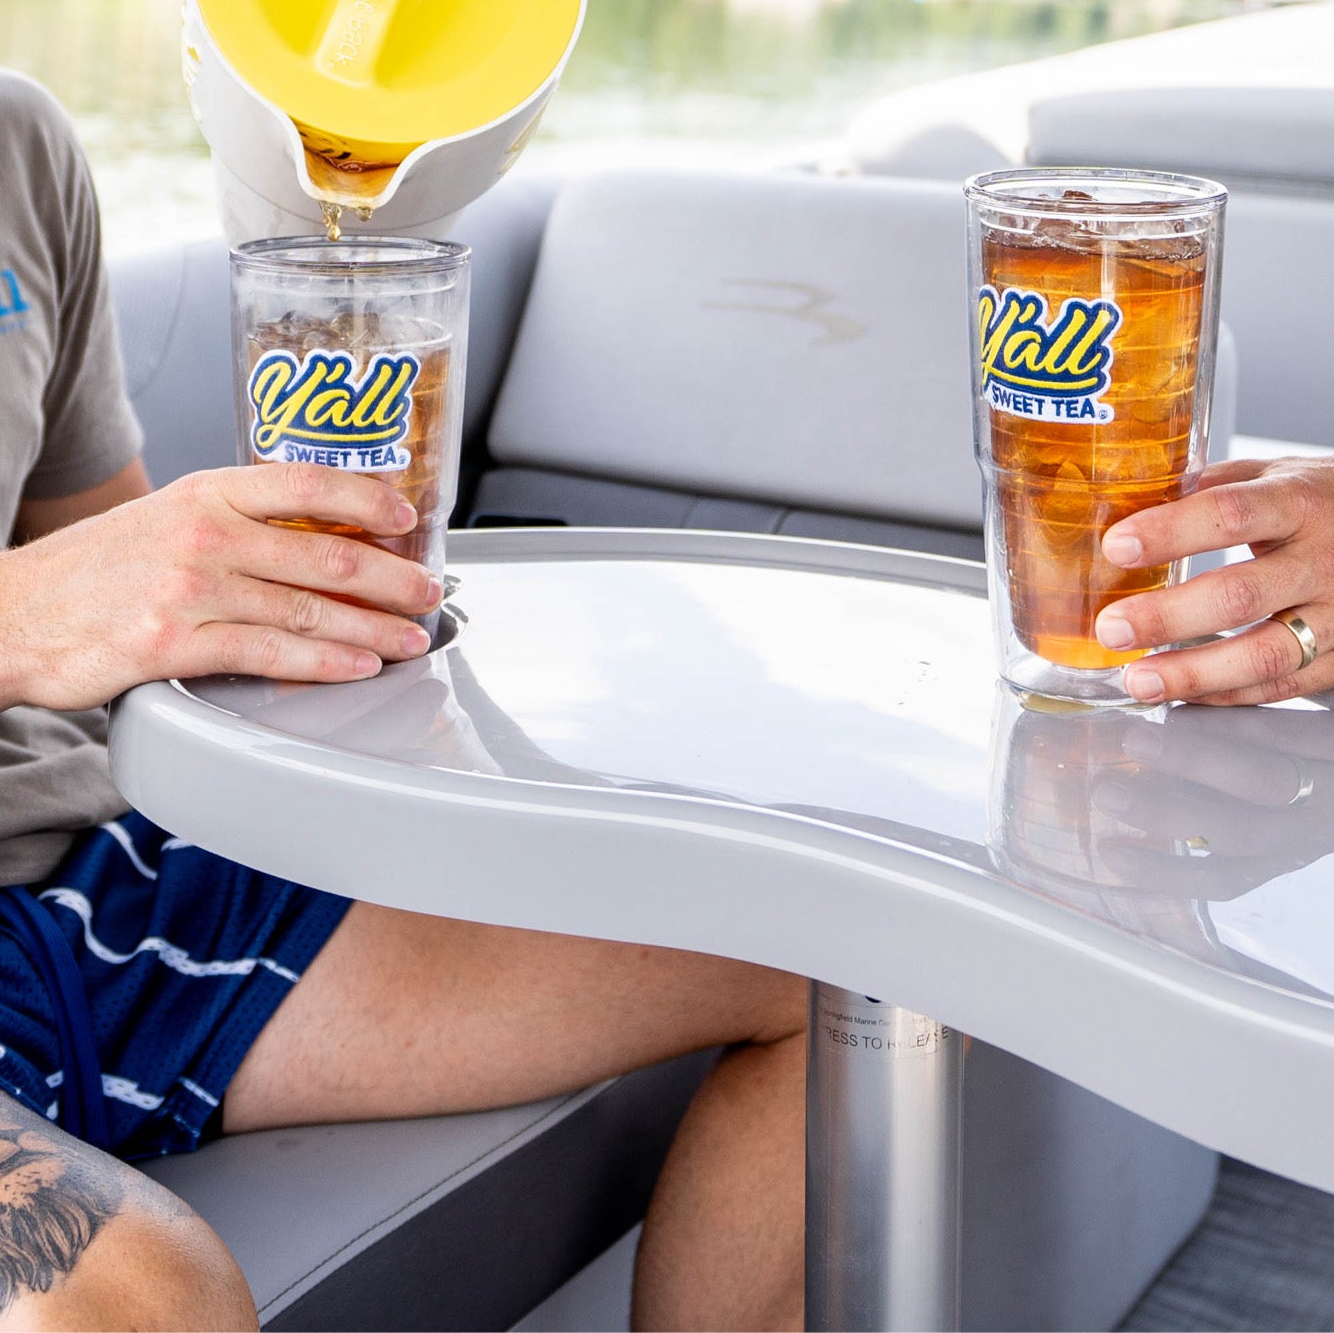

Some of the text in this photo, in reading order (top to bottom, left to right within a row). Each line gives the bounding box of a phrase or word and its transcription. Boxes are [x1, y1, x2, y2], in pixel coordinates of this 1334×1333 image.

[979, 291, 1118, 391] Y'all
[251, 354, 419, 453] Y'all
[991, 384, 1046, 417] SWEET
[284, 446, 352, 468] SWEET
[854, 1016, 877, 1026] Marine
[822, 1025, 949, 1050] RESS TO RLEE
